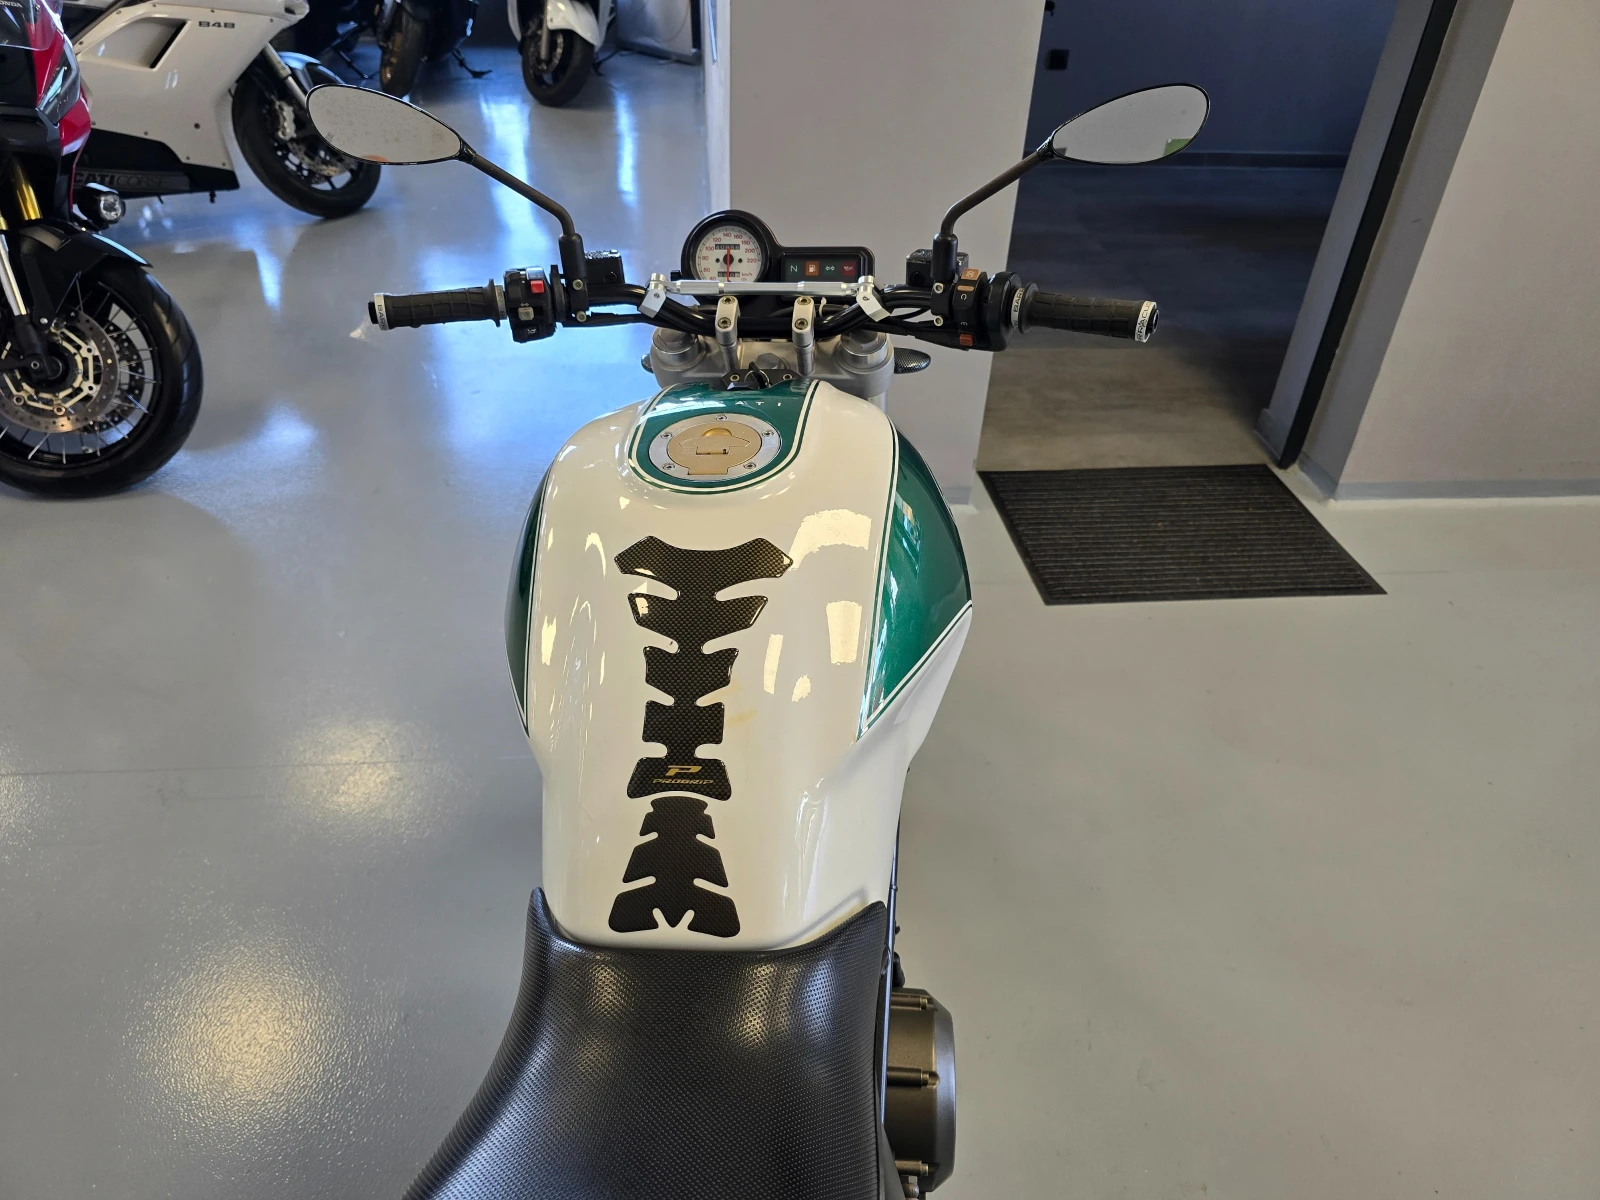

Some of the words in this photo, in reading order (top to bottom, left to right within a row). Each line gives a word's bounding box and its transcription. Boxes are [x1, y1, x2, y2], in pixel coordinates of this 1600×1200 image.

[0, 0, 23, 8] ONDA
[198, 21, 236, 29] 848
[790, 265, 798, 273] N
[665, 765, 702, 776] P
